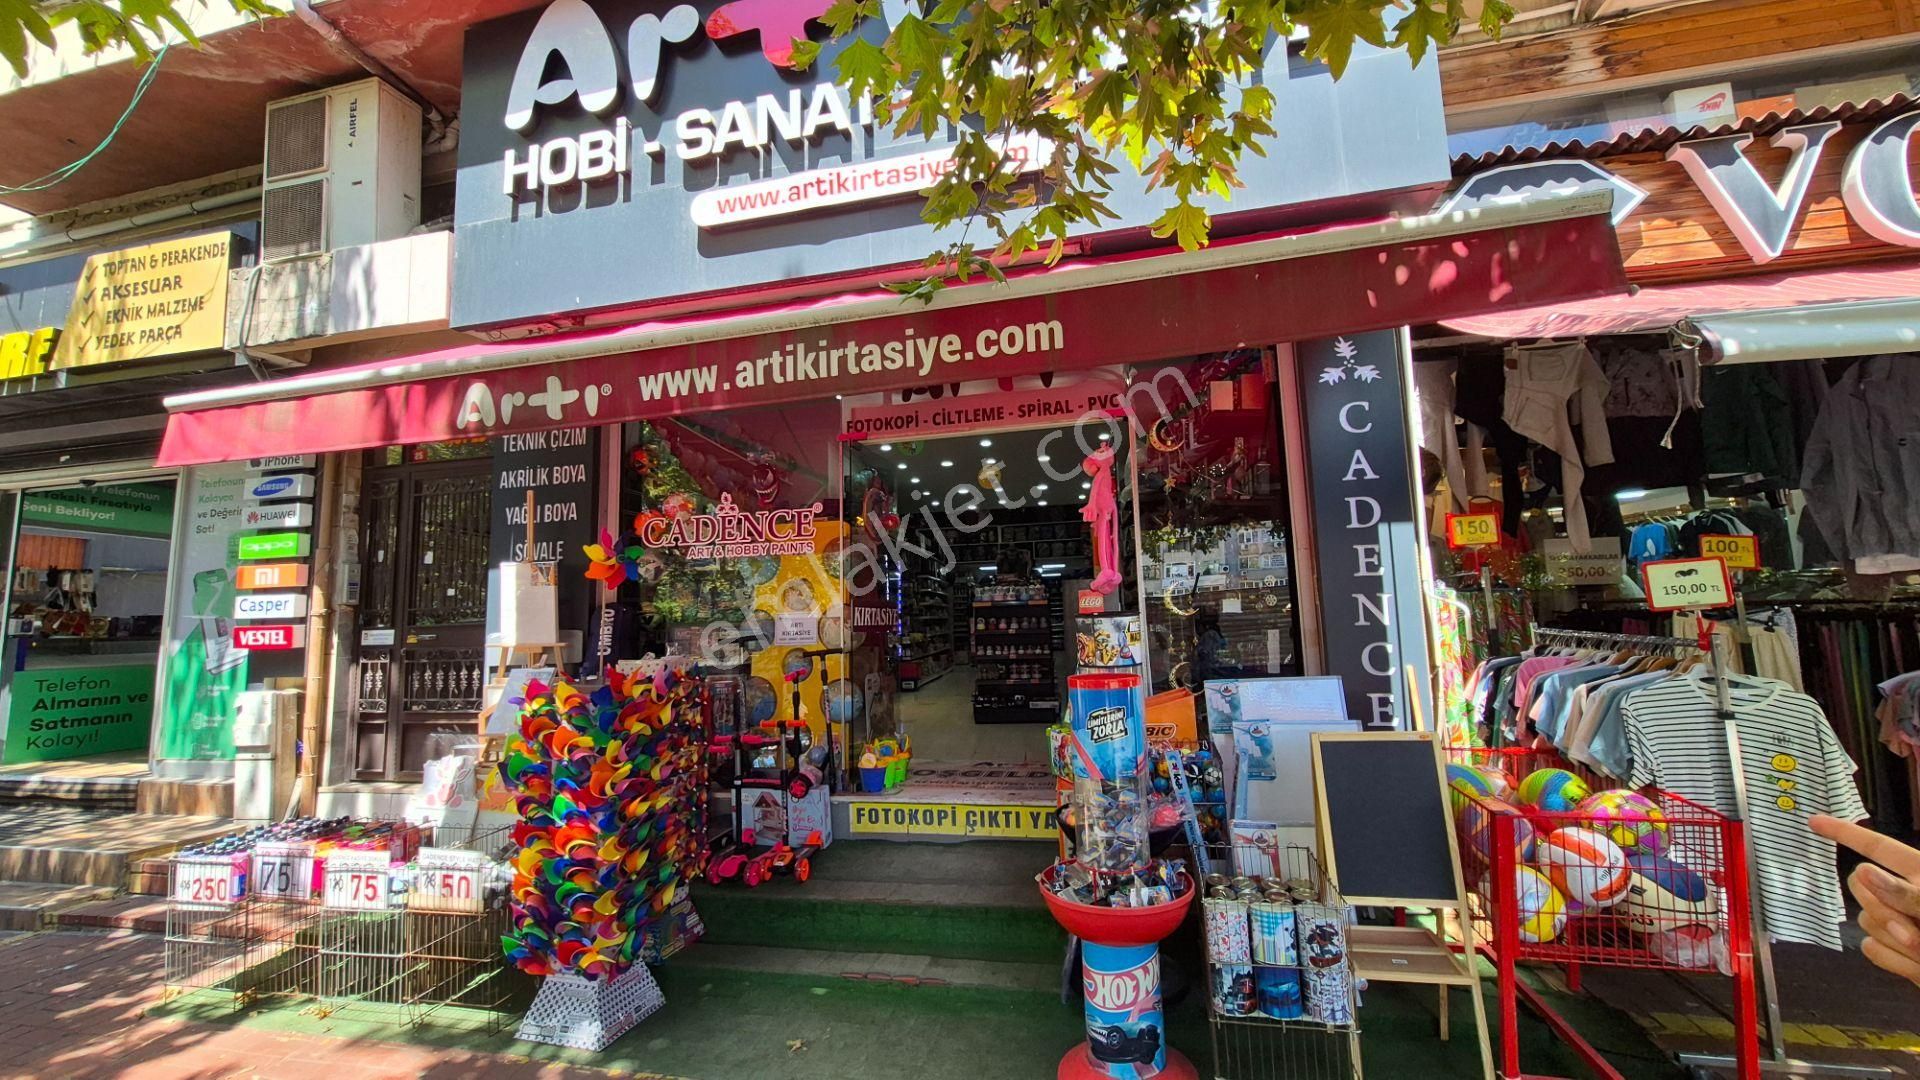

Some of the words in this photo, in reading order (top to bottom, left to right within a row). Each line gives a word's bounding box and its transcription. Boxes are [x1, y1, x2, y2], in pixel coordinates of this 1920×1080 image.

[348, 97, 358, 138] AIRFEL
[503, 117, 632, 196] HOBİ
[103, 256, 146, 277] TOPTAN
[149, 254, 158, 269] &
[161, 242, 226, 267] PERAKENDE
[100, 275, 183, 301] AKSESUAR
[147, 295, 205, 320] MALZEME
[95, 331, 136, 350] YEDEK
[139, 324, 182, 345] PARÇA
[0, 326, 55, 380] RE
[638, 320, 1064, 402] www.artikirtasiye.com
[846, 409, 920, 433] FOTOKOPİ
[932, 404, 1005, 427] CİLTLEME
[1017, 397, 1074, 418] SPİRAL
[1087, 393, 1120, 411] PVC
[499, 465, 549, 490] AKRİLİK
[553, 463, 586, 485] BOYA
[22, 500, 51, 513] Seni
[55, 504, 116, 521] Bekliyor!
[260, 510, 296, 521] HUAWEI
[505, 503, 540, 526] YAĞI
[543, 502, 578, 523] BOYA
[1455, 519, 1490, 536] 150
[687, 547, 712, 559] ART
[714, 547, 724, 557] &
[725, 543, 770, 558] HOBBY
[771, 541, 815, 555] PAINTS
[1705, 539, 1739, 554] 100
[1338, 400, 1400, 728] CADENCE
[1081, 596, 1103, 607] LEGO
[1662, 582, 1707, 597] 150,00
[1710, 584, 1721, 592] TL
[239, 598, 290, 615] Casper
[239, 628, 288, 646] VESTEL
[34, 675, 111, 693] Telefon
[31, 695, 121, 713] Almanın
[127, 692, 149, 704] ve
[28, 713, 133, 732] Satmanın
[1092, 720, 1125, 739] ZORLA
[26, 729, 99, 750] Kolayı!
[856, 805, 957, 828] FOTOKOPİ
[966, 809, 1021, 833] ÇIKTI
[192, 877, 227, 902] 250
[261, 861, 291, 893] 75
[350, 873, 379, 902] 75
[441, 873, 471, 899] 50
